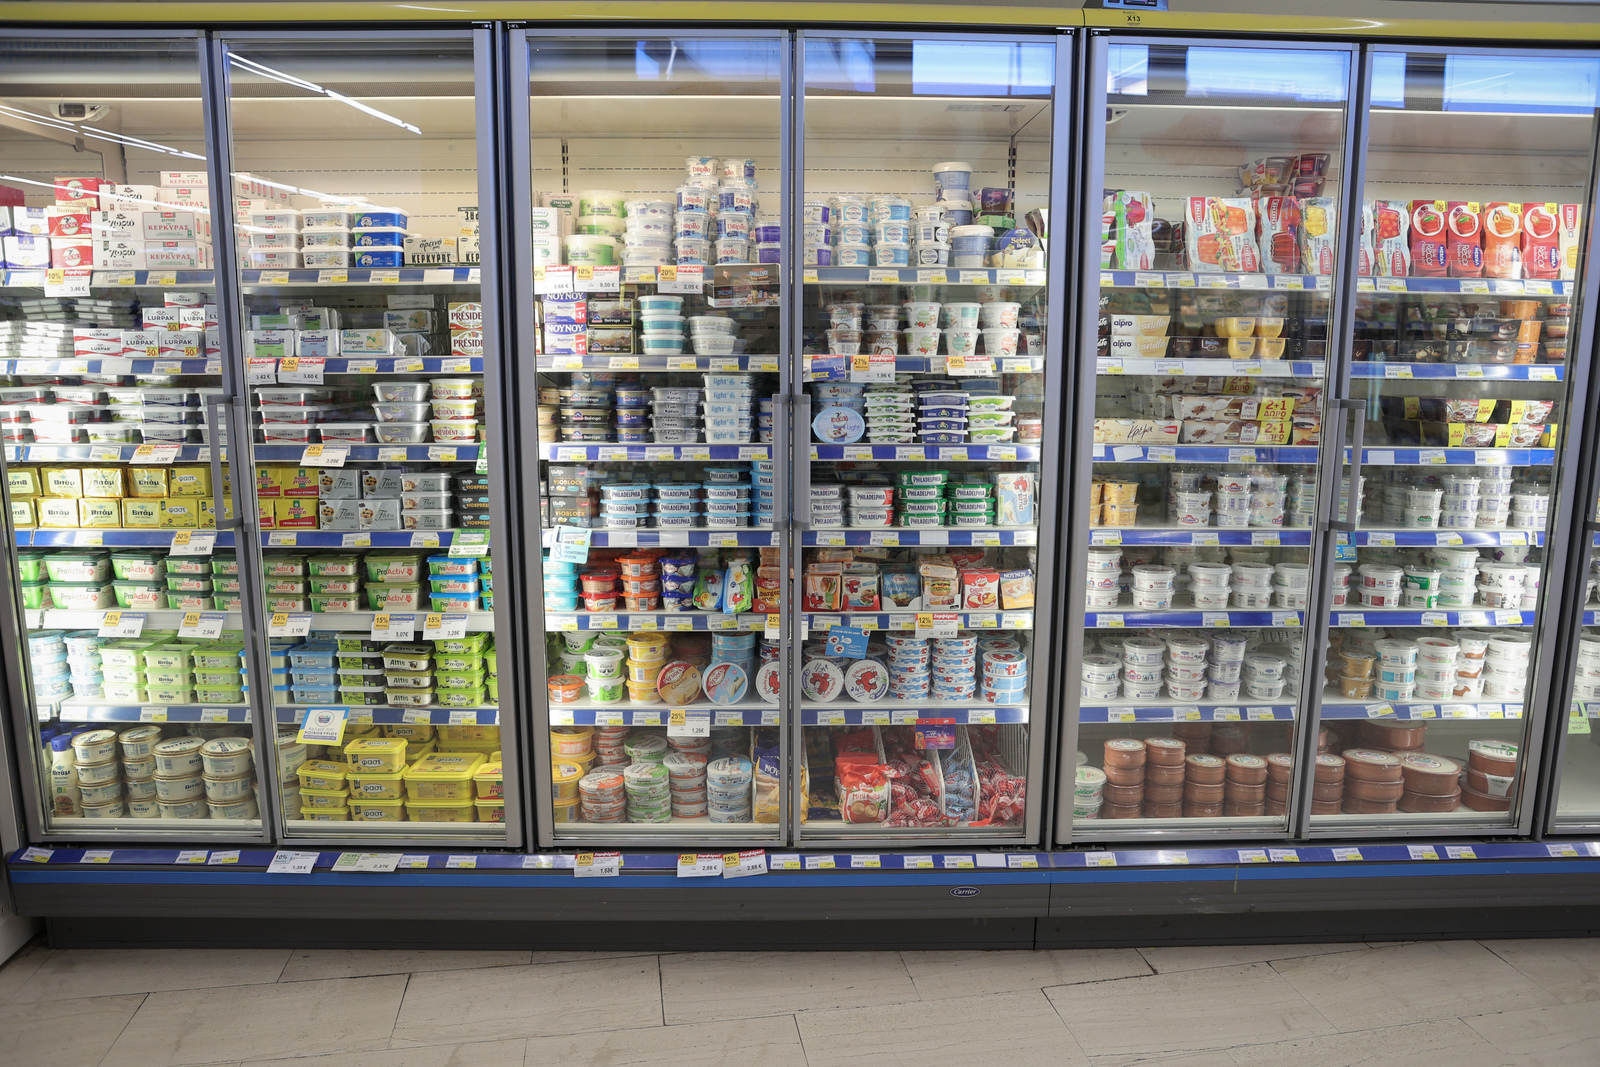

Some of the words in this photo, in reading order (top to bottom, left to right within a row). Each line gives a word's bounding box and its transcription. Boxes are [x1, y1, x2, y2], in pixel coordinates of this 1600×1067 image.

[1127, 15, 1140, 24] X13
[1011, 237, 1031, 245] Select
[411, 253, 451, 263] ΚΕΡΚΥΡΑΣ
[1114, 319, 1132, 327] alpro
[547, 324, 584, 332] NOYNOY
[854, 358, 867, 366] 27%
[1266, 400, 1286, 410] 2+1
[1265, 423, 1284, 433] 2+1
[708, 489, 737, 497] PHILADELPHIA
[608, 504, 636, 512] PHILADELPHIA
[121, 565, 148, 573] ProActiv
[376, 567, 405, 576] ProActiv
[1003, 571, 1026, 579] NOYNOY
[124, 592, 150, 600] ProActiv
[376, 594, 403, 602] ProActiv
[361, 758, 383, 766] φαστ
[361, 784, 384, 792] φαστ
[954, 888, 977, 896] Carrier
